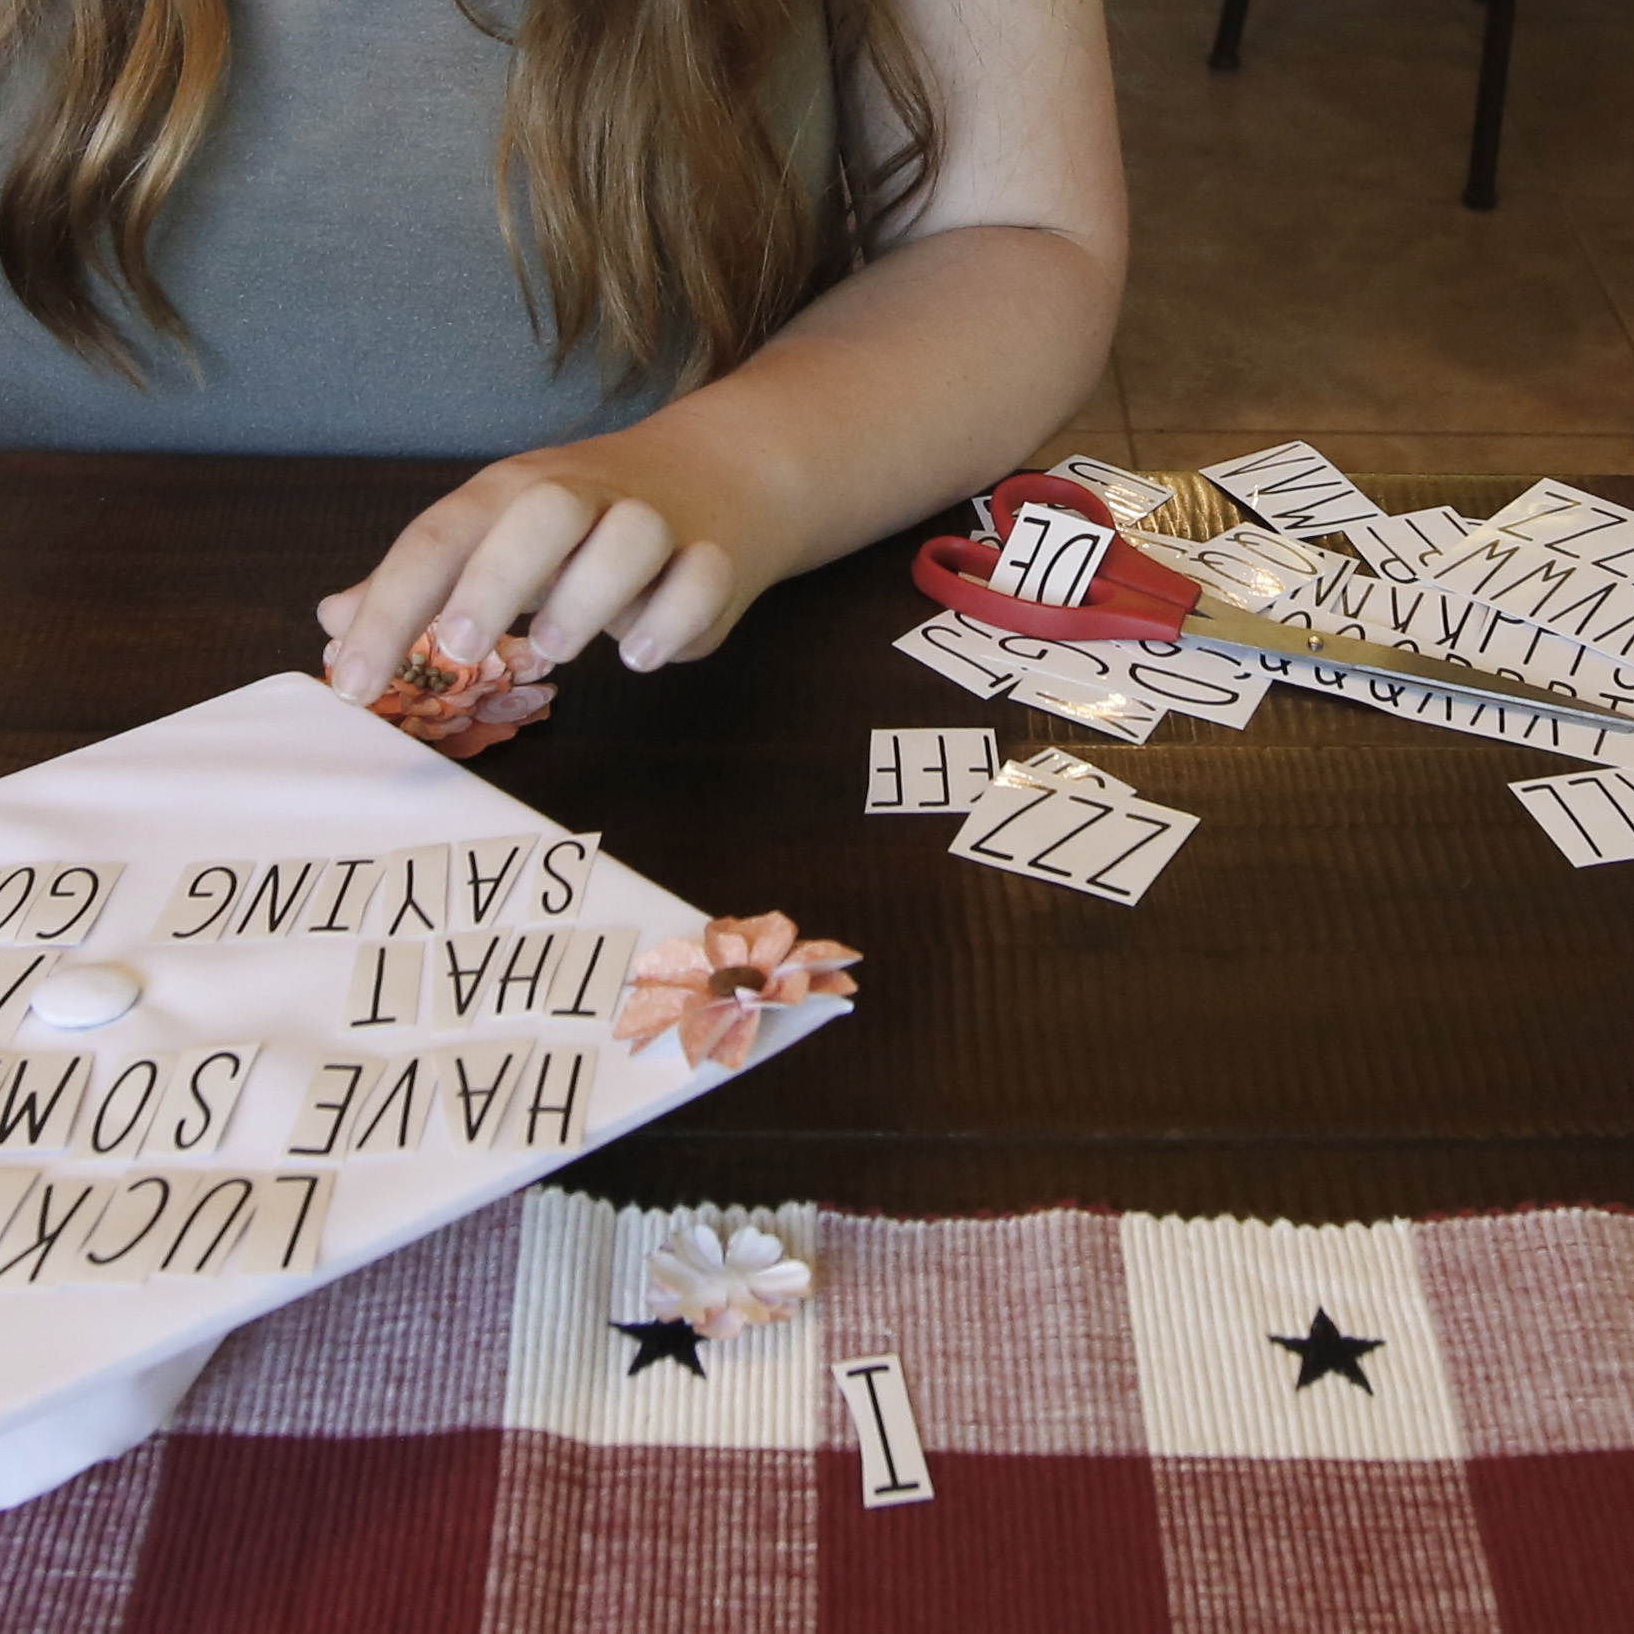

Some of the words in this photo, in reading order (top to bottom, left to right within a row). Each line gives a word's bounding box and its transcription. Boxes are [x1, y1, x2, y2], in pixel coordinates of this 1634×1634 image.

[172, 840, 586, 939] SAYING
[351, 933, 604, 1028] THAT
[287, 1052, 583, 1156] HAVE
